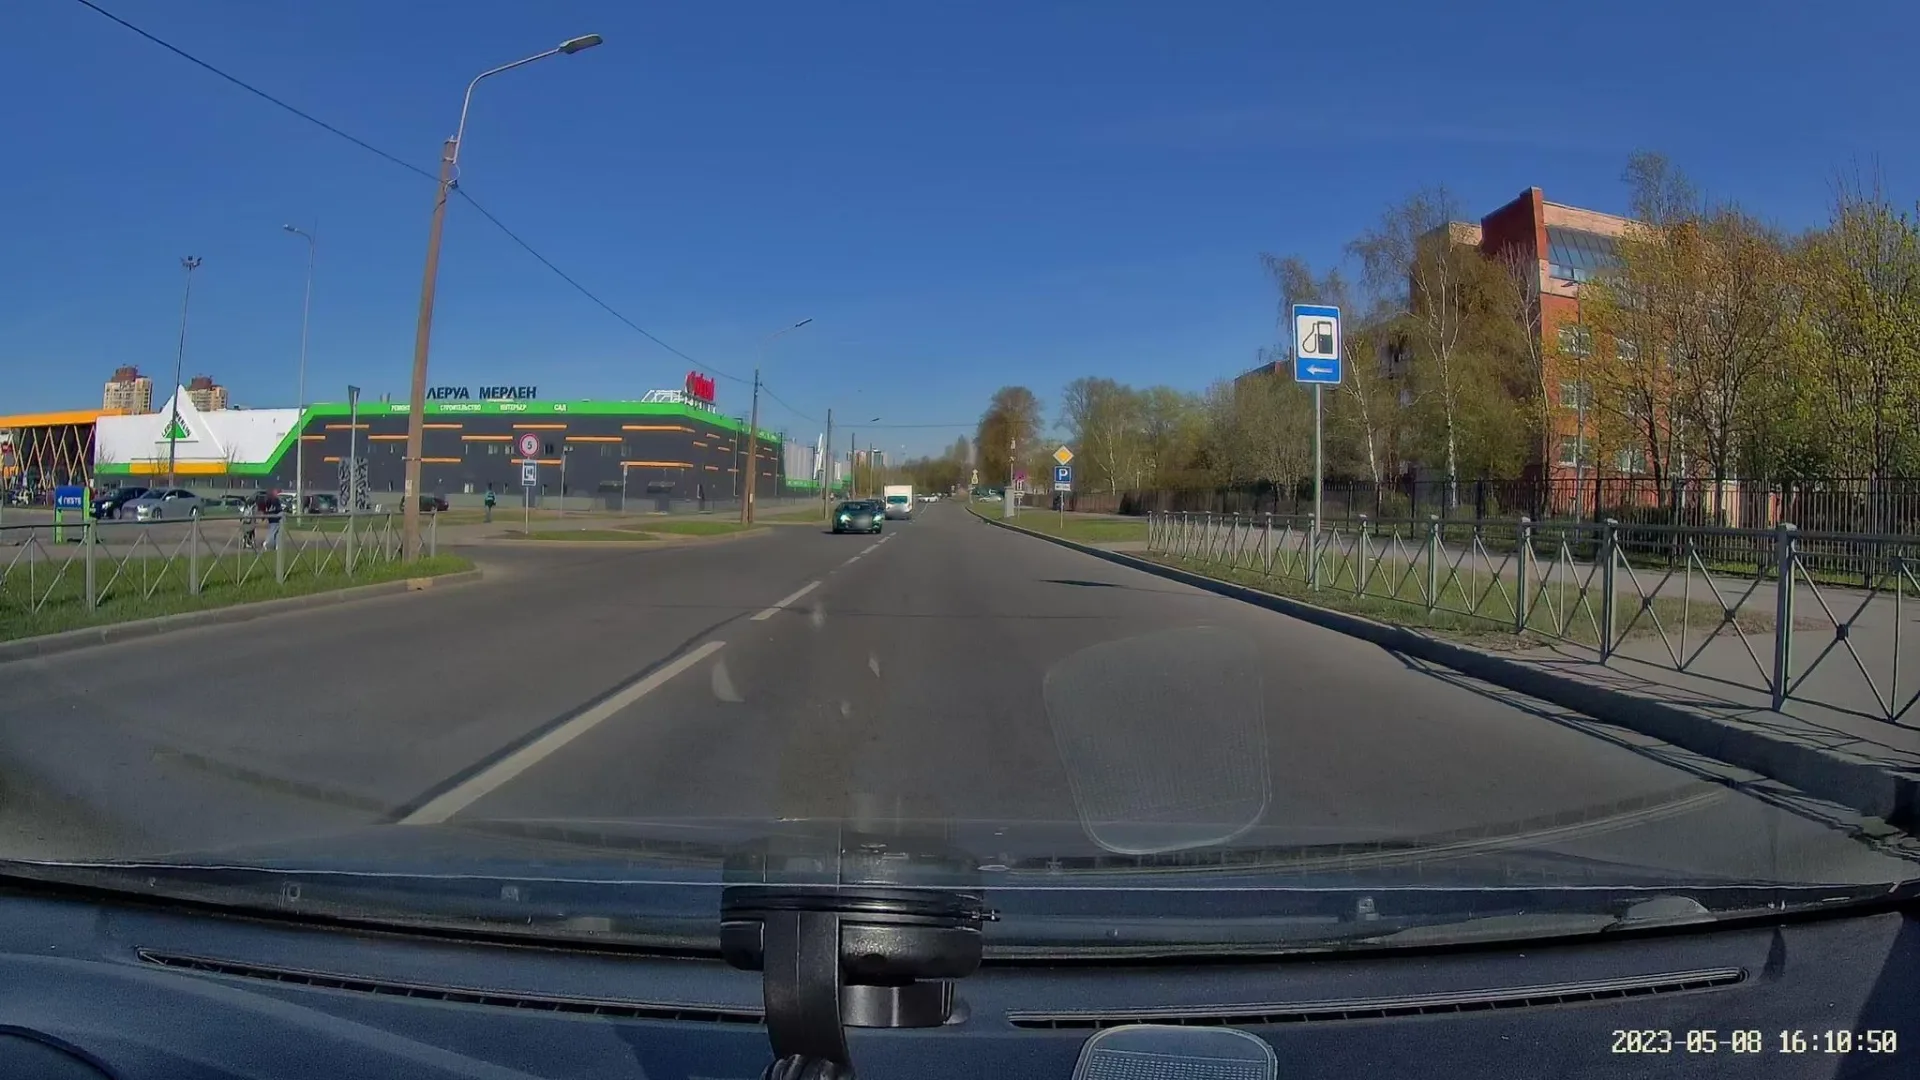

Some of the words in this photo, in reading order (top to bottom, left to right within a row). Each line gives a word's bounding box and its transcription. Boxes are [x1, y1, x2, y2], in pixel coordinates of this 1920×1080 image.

[426, 387, 470, 400] ЛЕРУА
[479, 386, 537, 400] МЕРЛЕН
[553, 403, 567, 412] САД
[527, 440, 533, 450] 5
[1058, 468, 1068, 481] P
